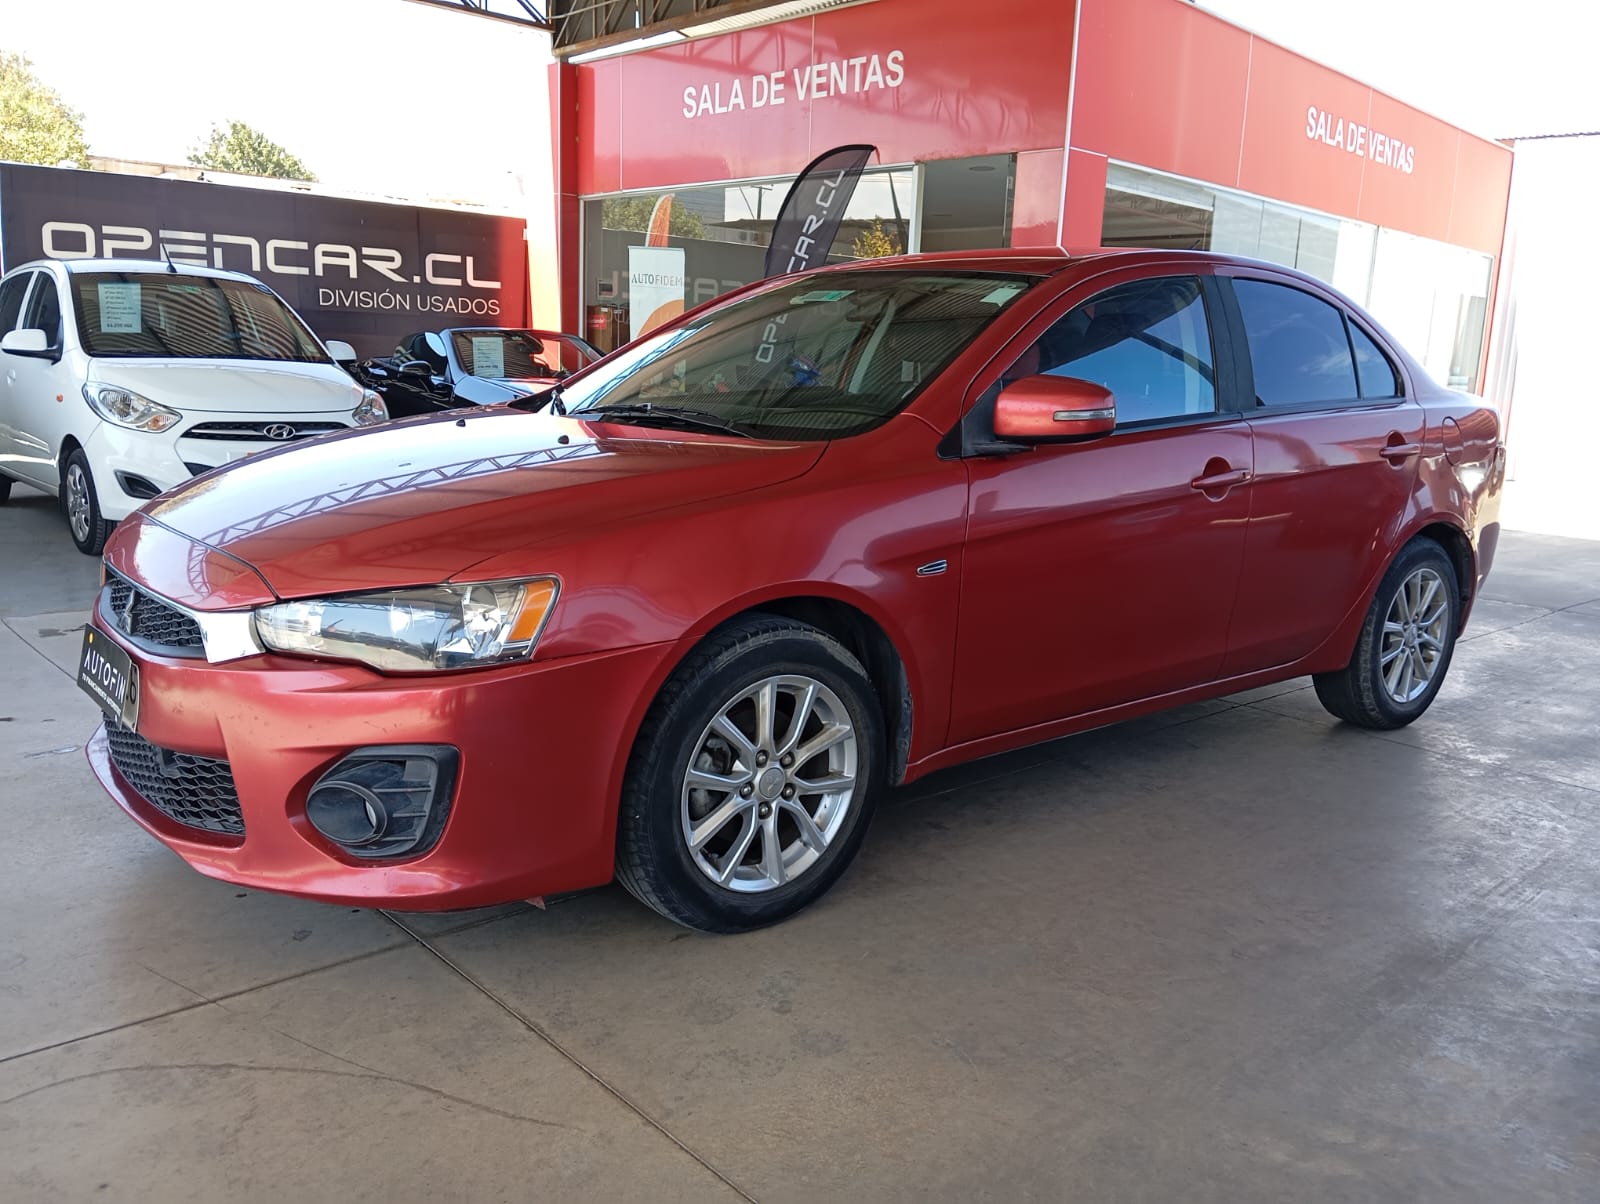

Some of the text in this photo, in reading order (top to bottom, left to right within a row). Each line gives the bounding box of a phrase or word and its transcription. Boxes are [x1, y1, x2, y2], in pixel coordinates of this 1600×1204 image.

[682, 49, 905, 119] SALA DE VENTAS
[1305, 105, 1416, 175] SALA DE VENTAS
[41, 221, 502, 289] OPENCAR.CL
[631, 273, 683, 288] AUTOFIDEM
[319, 288, 501, 316] DIVISIÓN USADOS
[83, 647, 126, 704] AUTOFIN
